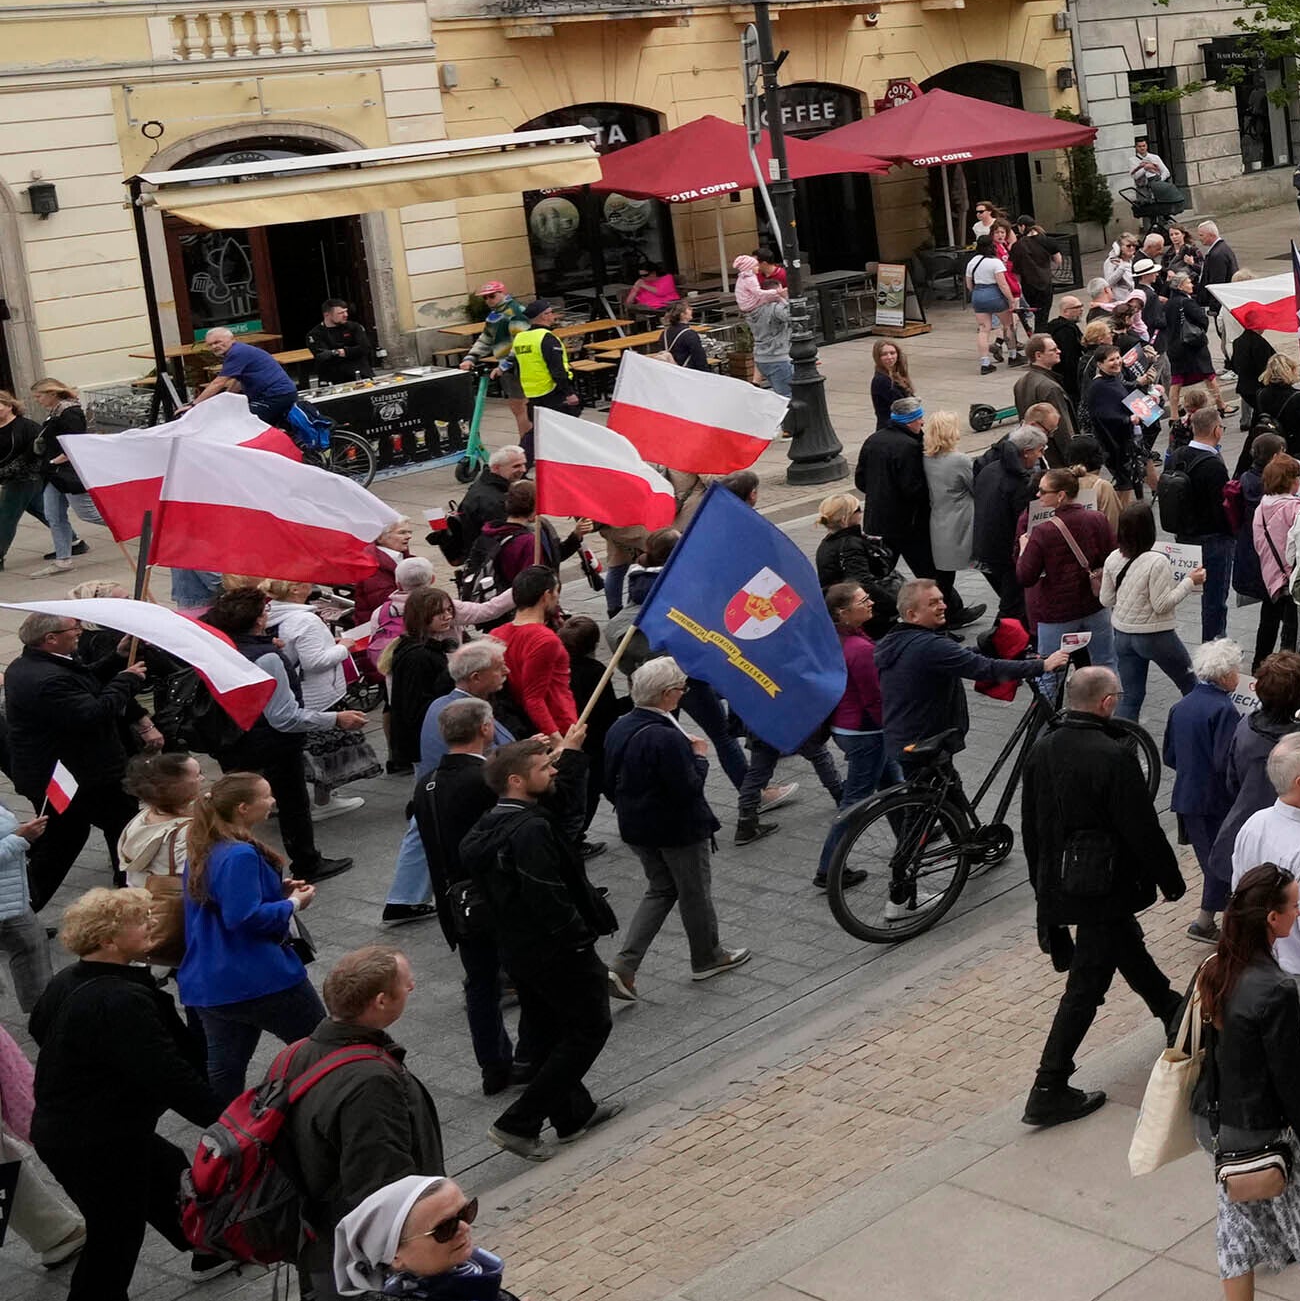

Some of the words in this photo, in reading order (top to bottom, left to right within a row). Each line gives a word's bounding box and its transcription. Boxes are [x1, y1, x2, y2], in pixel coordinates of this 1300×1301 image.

[888, 84, 914, 99] COSTA
[760, 102, 835, 126] OFFEE
[913, 156, 941, 166] COSTA
[943, 152, 973, 162] COFFEE
[700, 181, 739, 194] COFFEE
[1032, 510, 1055, 521] NIEC
[710, 634, 738, 656] KORONY
[740, 660, 773, 688] POLSKIEJ
[1231, 693, 1260, 708] IECH
